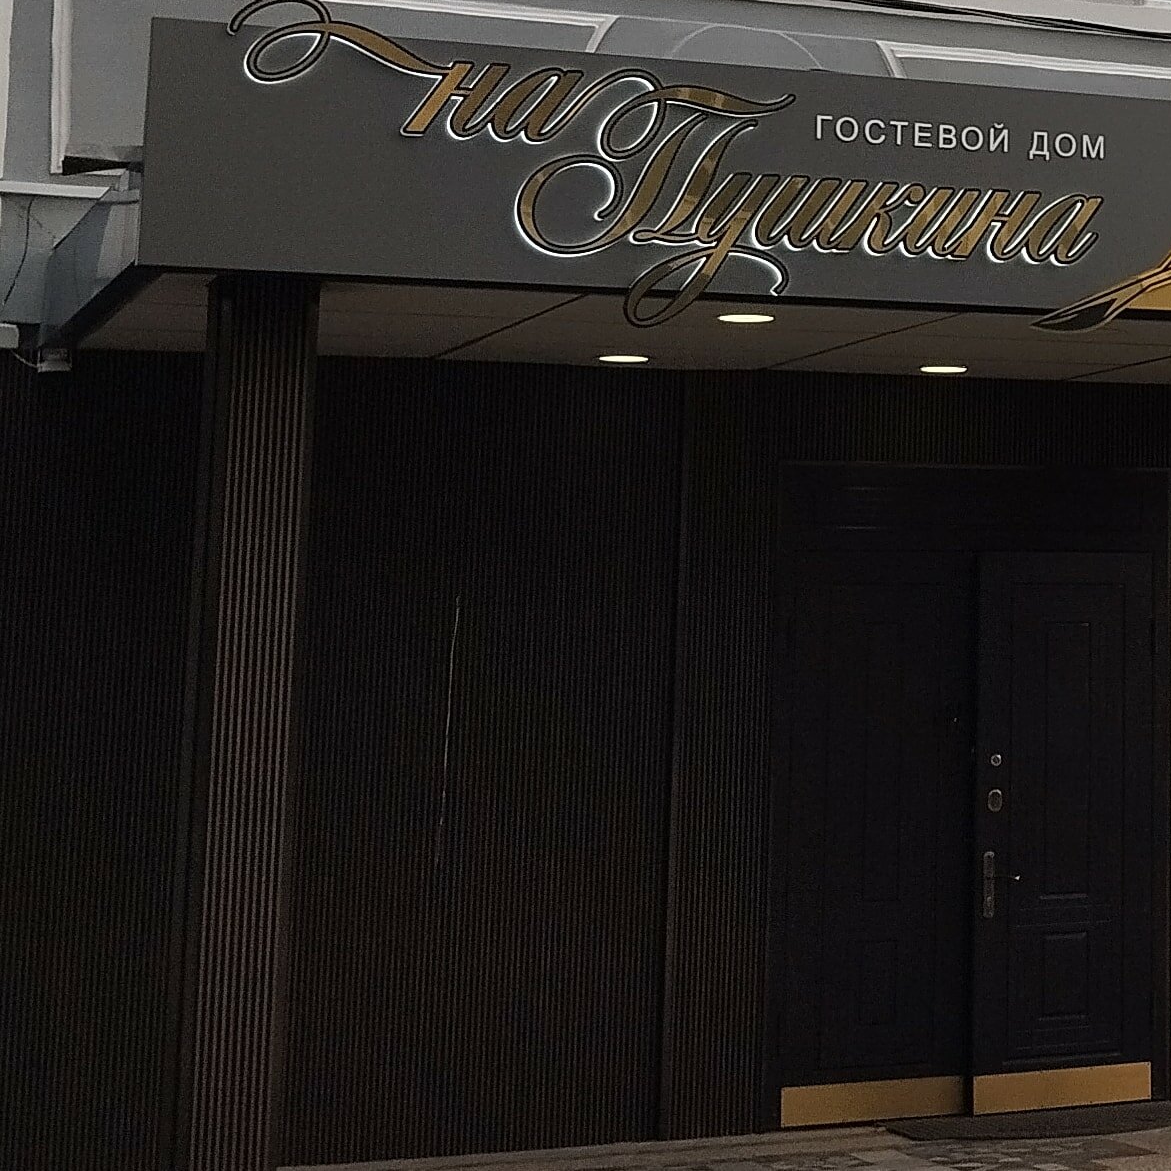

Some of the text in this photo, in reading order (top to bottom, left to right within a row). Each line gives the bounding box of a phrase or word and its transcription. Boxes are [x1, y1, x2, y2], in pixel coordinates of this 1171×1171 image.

[514, 68, 1104, 328] Пушкина
[815, 114, 1105, 161] ГОСТЕВОЙ ДОМ
